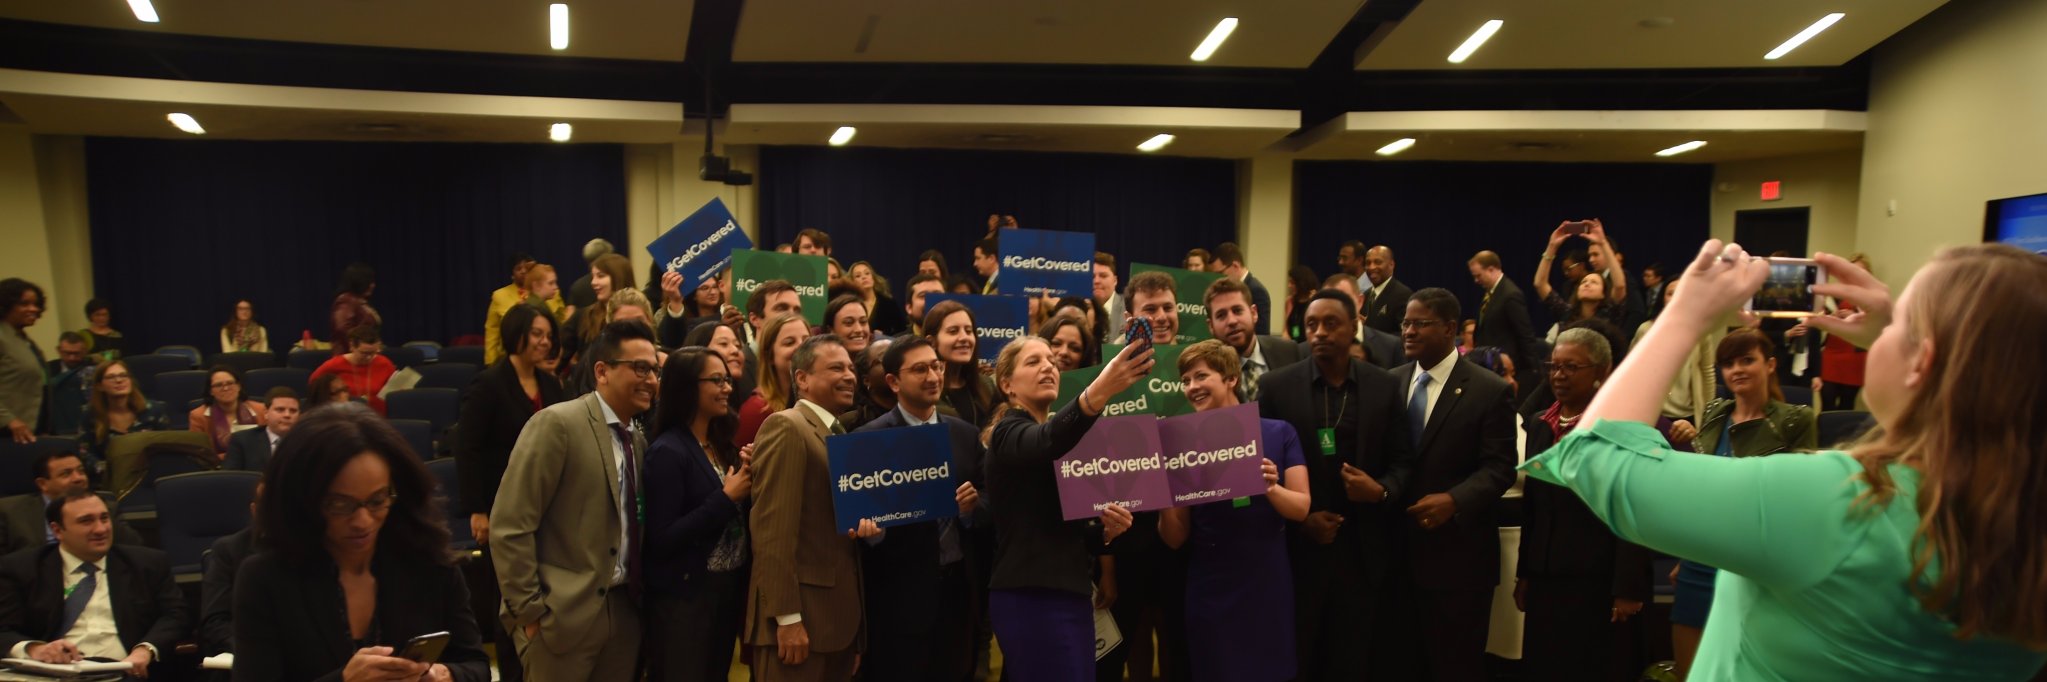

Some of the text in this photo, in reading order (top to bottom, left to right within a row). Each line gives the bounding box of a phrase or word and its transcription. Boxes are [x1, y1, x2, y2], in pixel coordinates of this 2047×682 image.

[666, 219, 736, 273] #GetCovered
[1003, 255, 1091, 272] #GetCovered
[736, 278, 824, 297] #Gered
[1061, 452, 1161, 478] #GetCovered
[1163, 440, 1257, 470] etCovered
[838, 461, 949, 492] #GetCovered
[1175, 488, 1231, 502] HealthCare.gov
[871, 509, 927, 523] HealthCare.gov
